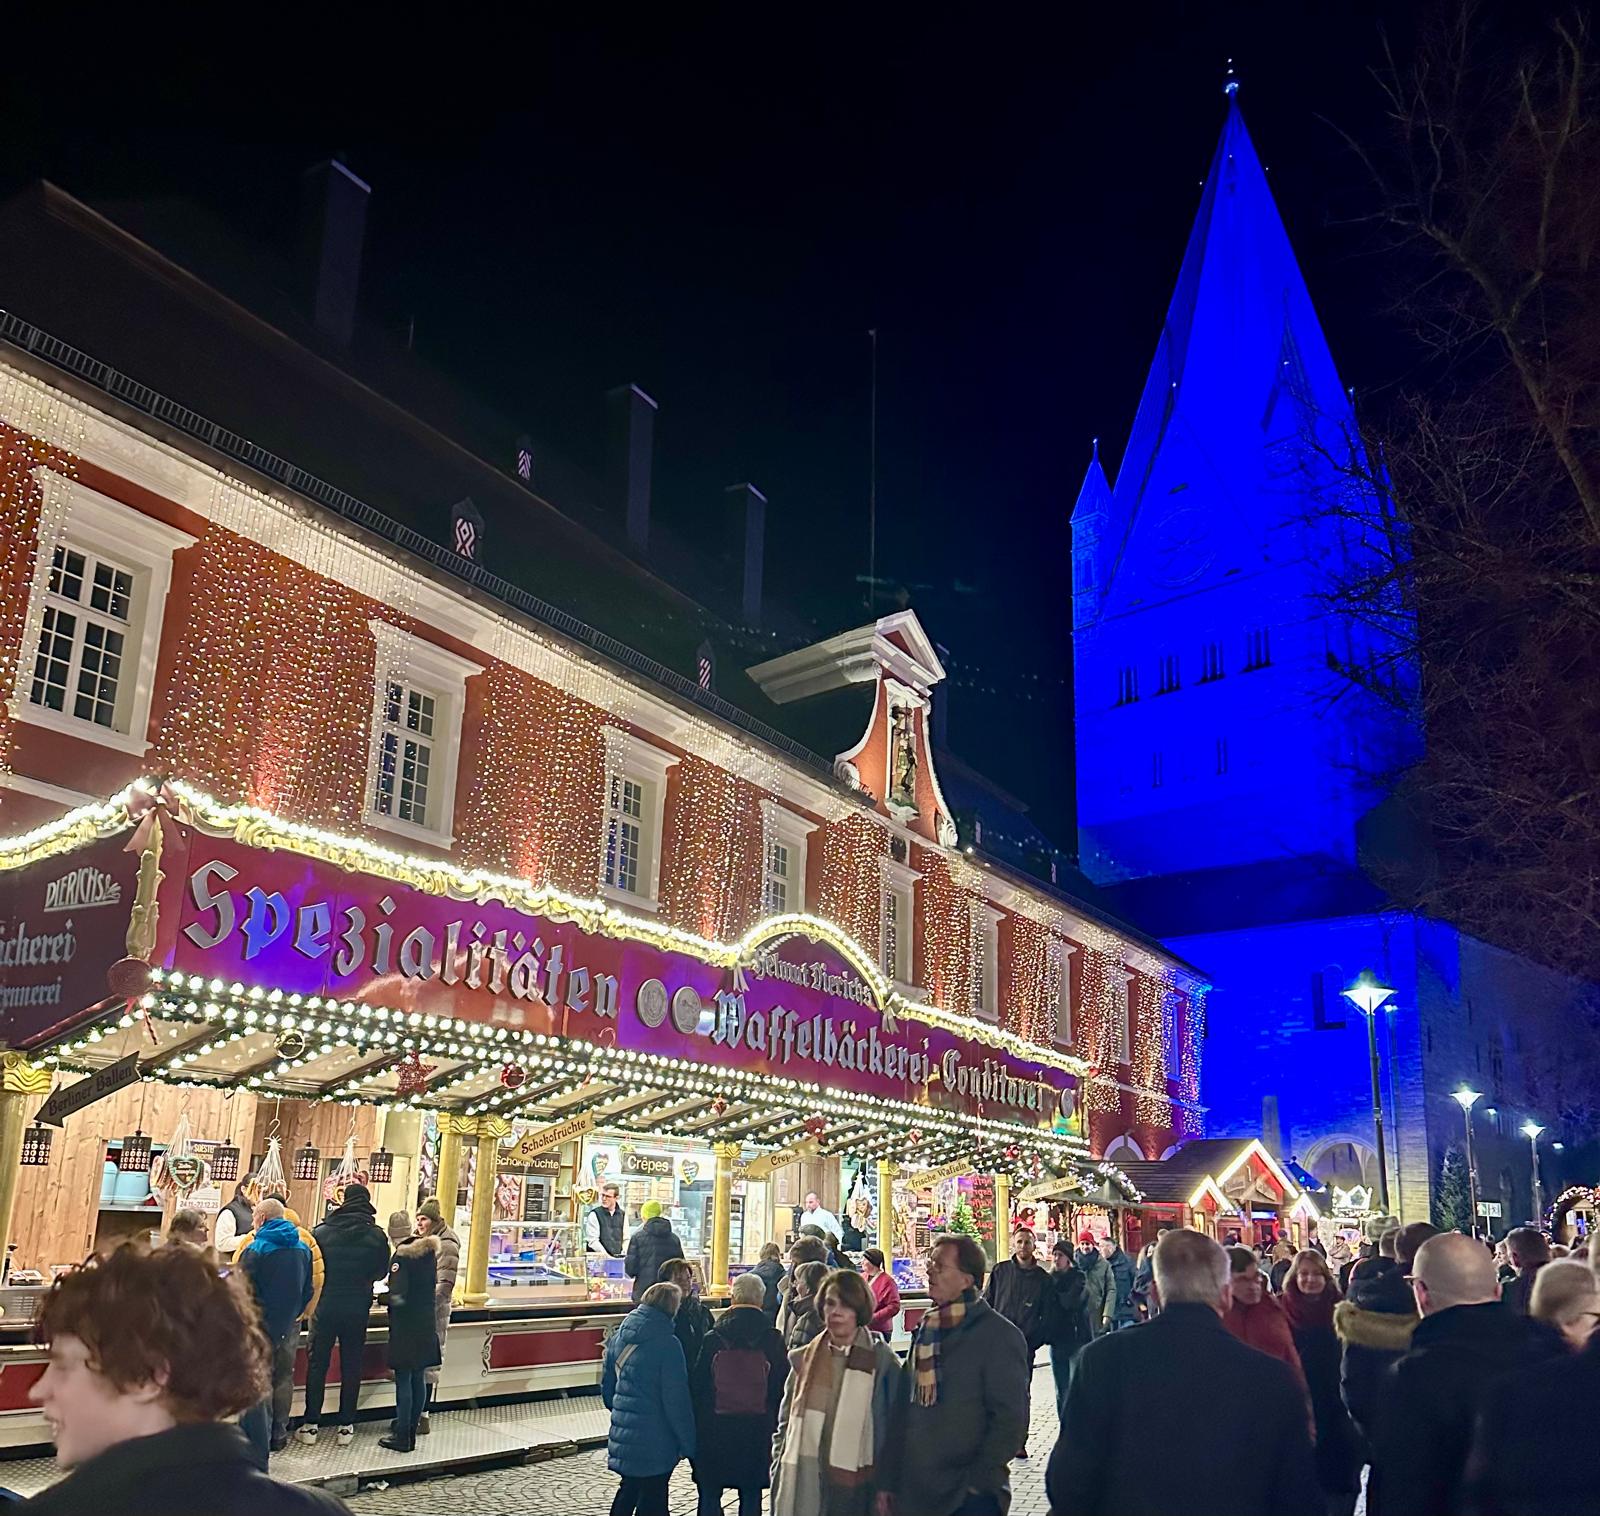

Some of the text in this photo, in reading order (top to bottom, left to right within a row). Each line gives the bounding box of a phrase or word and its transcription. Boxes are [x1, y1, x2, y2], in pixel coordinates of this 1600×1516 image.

[45, 867, 105, 907] DIERICHS
[181, 859, 618, 1019] Spezialitäten
[810, 962, 872, 1006] Dierichs
[710, 989, 930, 1085] Waffelbäckerei
[943, 1049, 1043, 1112] Conditorei
[48, 1065, 132, 1116] Berliner Ballen
[521, 1120, 586, 1155] Schokofrüchte
[627, 1156, 669, 1173] Crêpes
[911, 1174, 936, 1188] frische
[1052, 1180, 1074, 1191] Kakao
